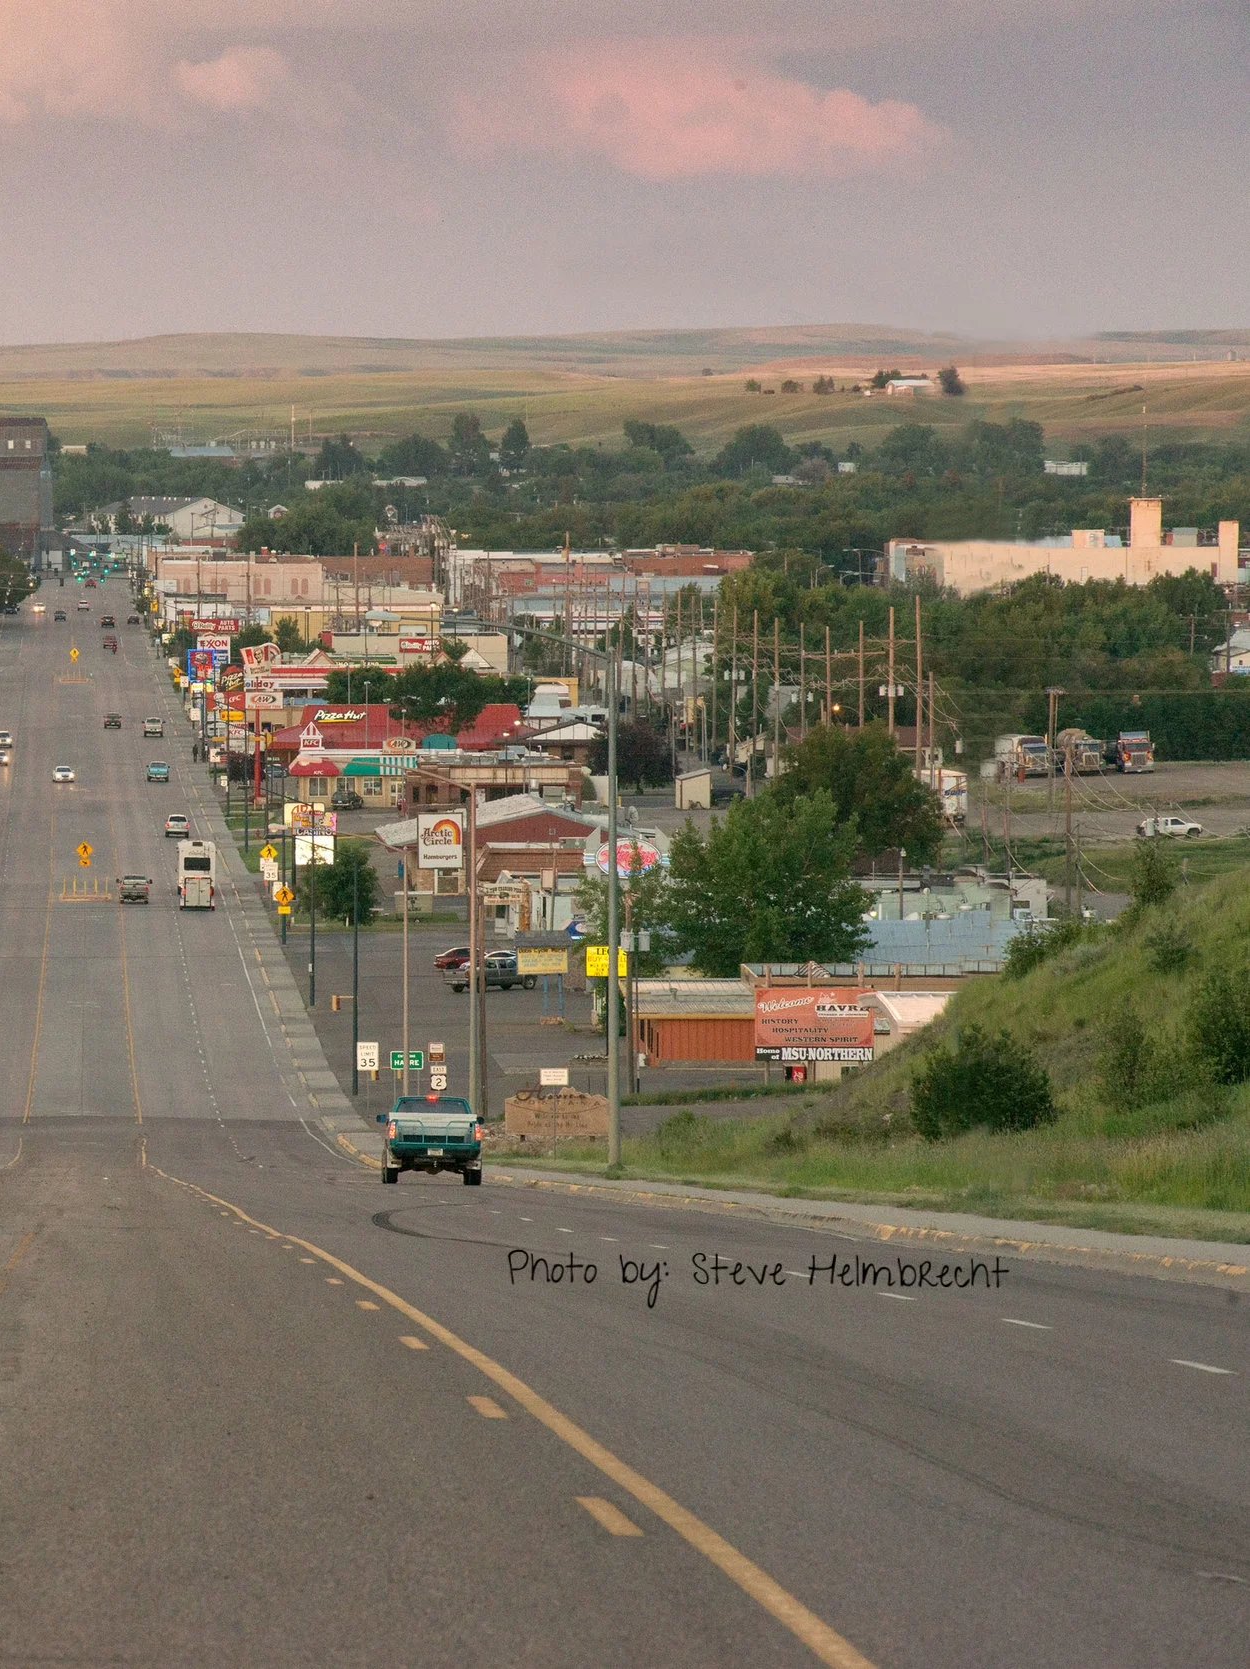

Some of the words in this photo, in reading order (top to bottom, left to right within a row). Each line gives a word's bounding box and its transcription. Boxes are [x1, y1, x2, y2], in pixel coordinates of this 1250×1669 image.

[200, 639, 228, 649] EXXON
[221, 672, 243, 684] Pizza
[245, 680, 275, 689] oliday
[229, 694, 242, 703] KFC
[313, 709, 343, 720] Pizza
[344, 709, 367, 720] Hut
[296, 828, 333, 836] CASINO
[421, 827, 453, 839] Arctic
[423, 837, 452, 846] Circle
[758, 996, 814, 1013] Welcome
[781, 1047, 873, 1061] MSU-NORTHERN
[360, 1058, 376, 1067] 35
